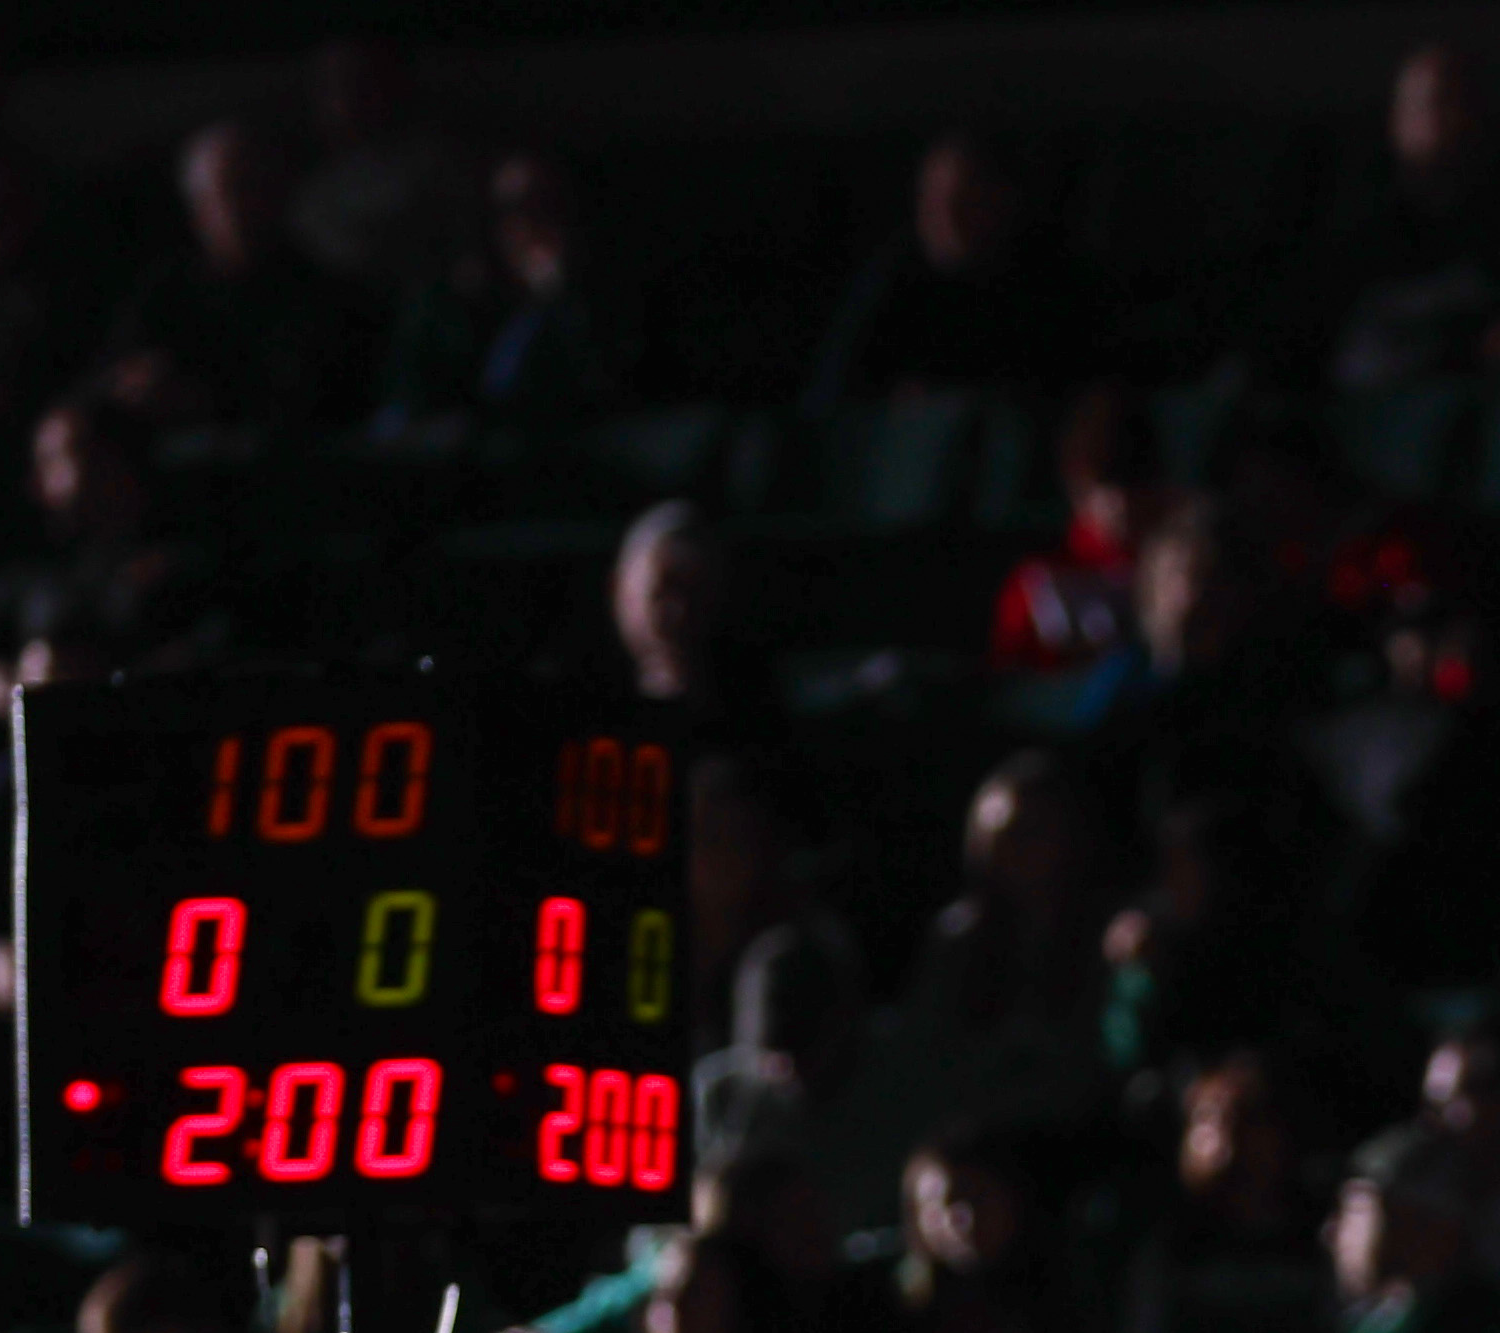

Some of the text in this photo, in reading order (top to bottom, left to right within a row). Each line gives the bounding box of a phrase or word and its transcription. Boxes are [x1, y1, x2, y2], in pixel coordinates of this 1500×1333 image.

[204, 720, 436, 844] 100
[159, 889, 438, 1017] 0 0
[533, 894, 588, 1017] 0
